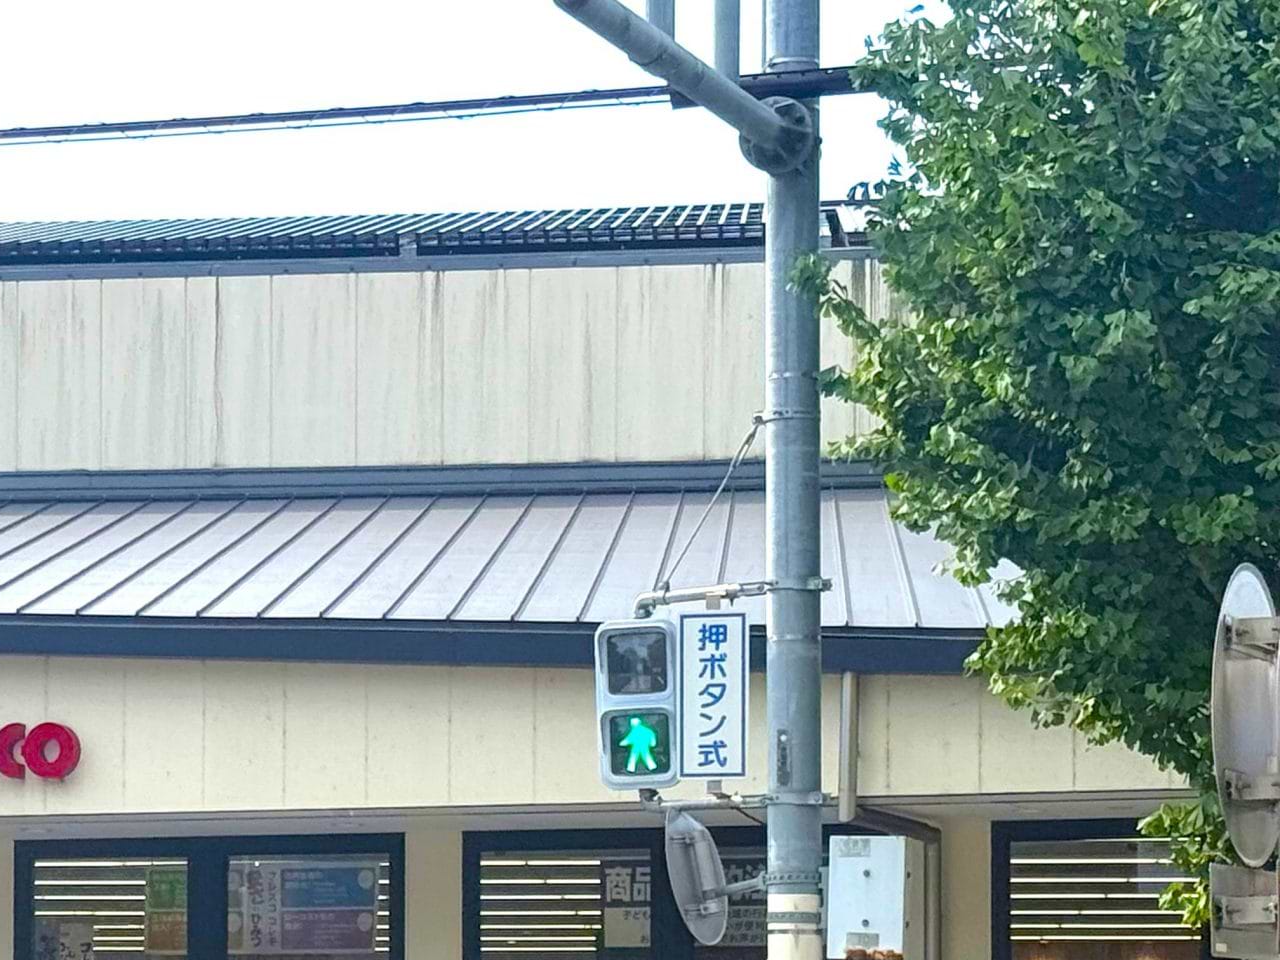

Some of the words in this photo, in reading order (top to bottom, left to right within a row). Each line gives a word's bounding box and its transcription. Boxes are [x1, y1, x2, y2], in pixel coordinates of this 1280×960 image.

[698, 624, 728, 768] 押ボタン式
